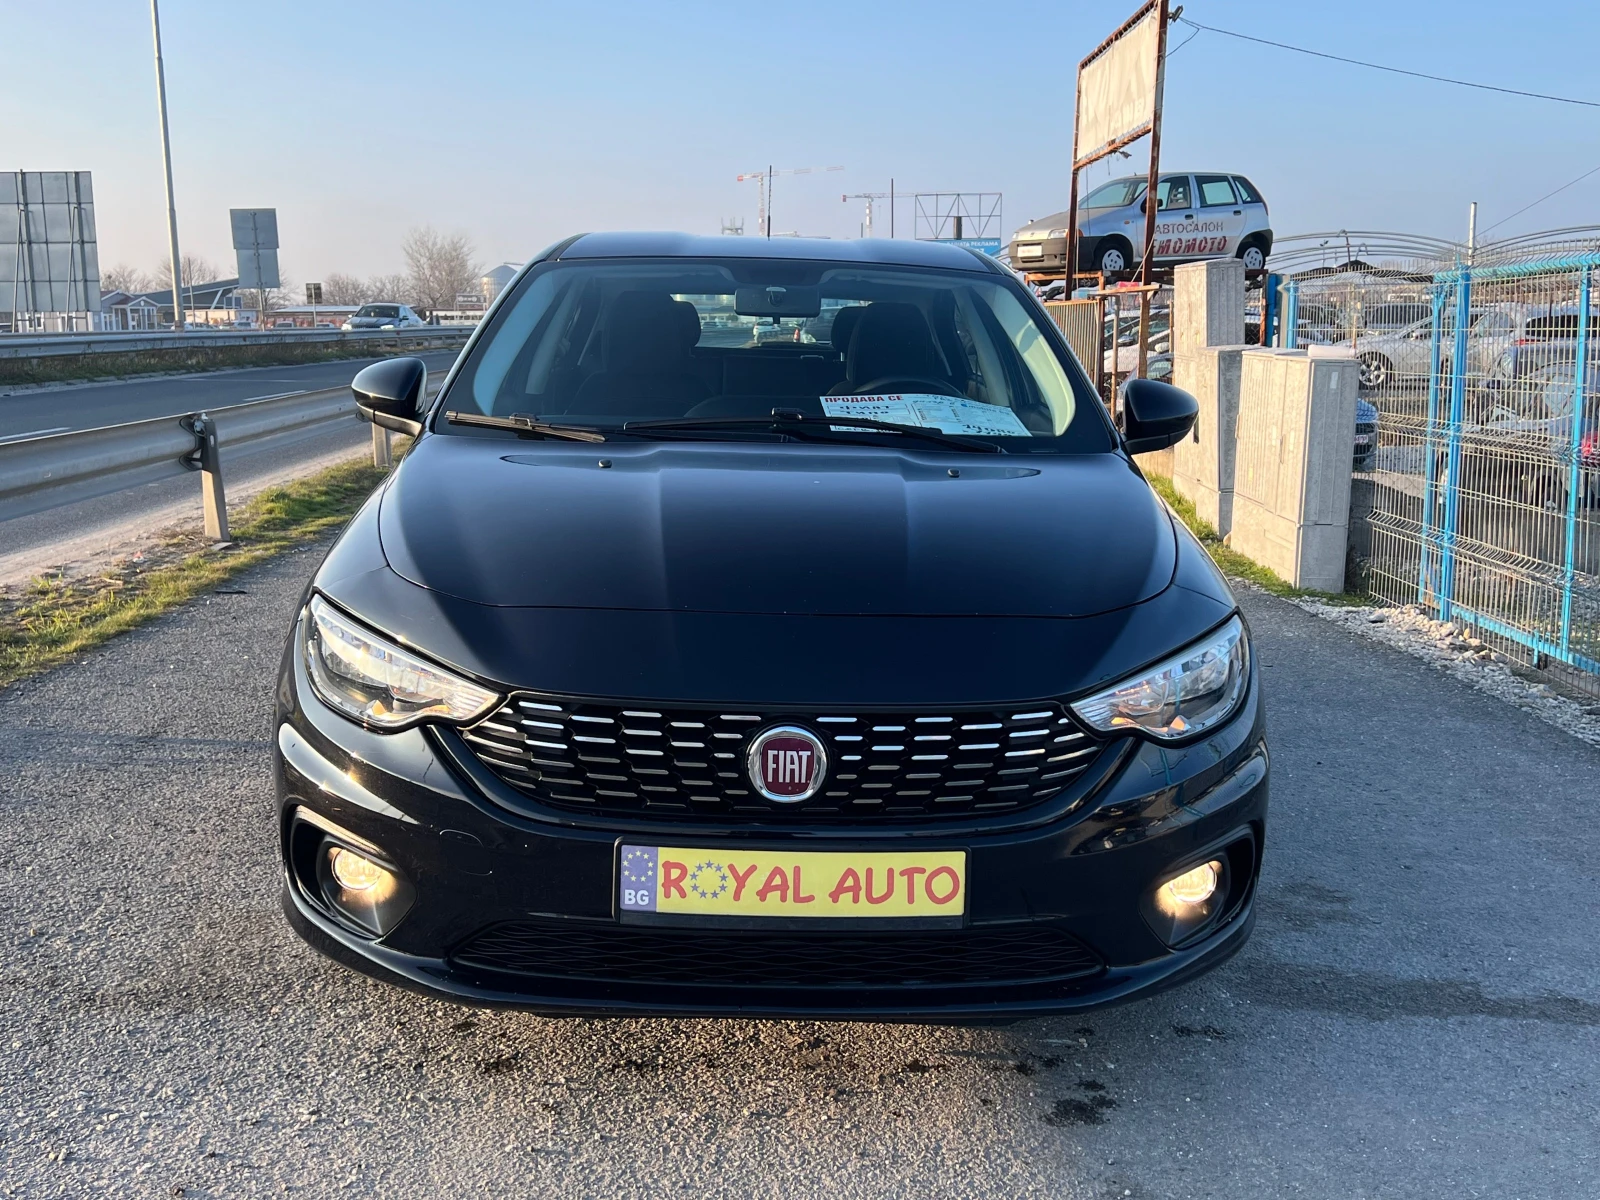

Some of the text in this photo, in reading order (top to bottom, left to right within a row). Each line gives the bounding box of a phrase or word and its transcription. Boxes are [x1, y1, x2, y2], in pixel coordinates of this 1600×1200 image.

[1155, 221, 1224, 235] АВТОСАЛОН
[767, 750, 811, 783] FIAT
[661, 861, 960, 905] ROYAL AUTO
[624, 889, 649, 905] BG
